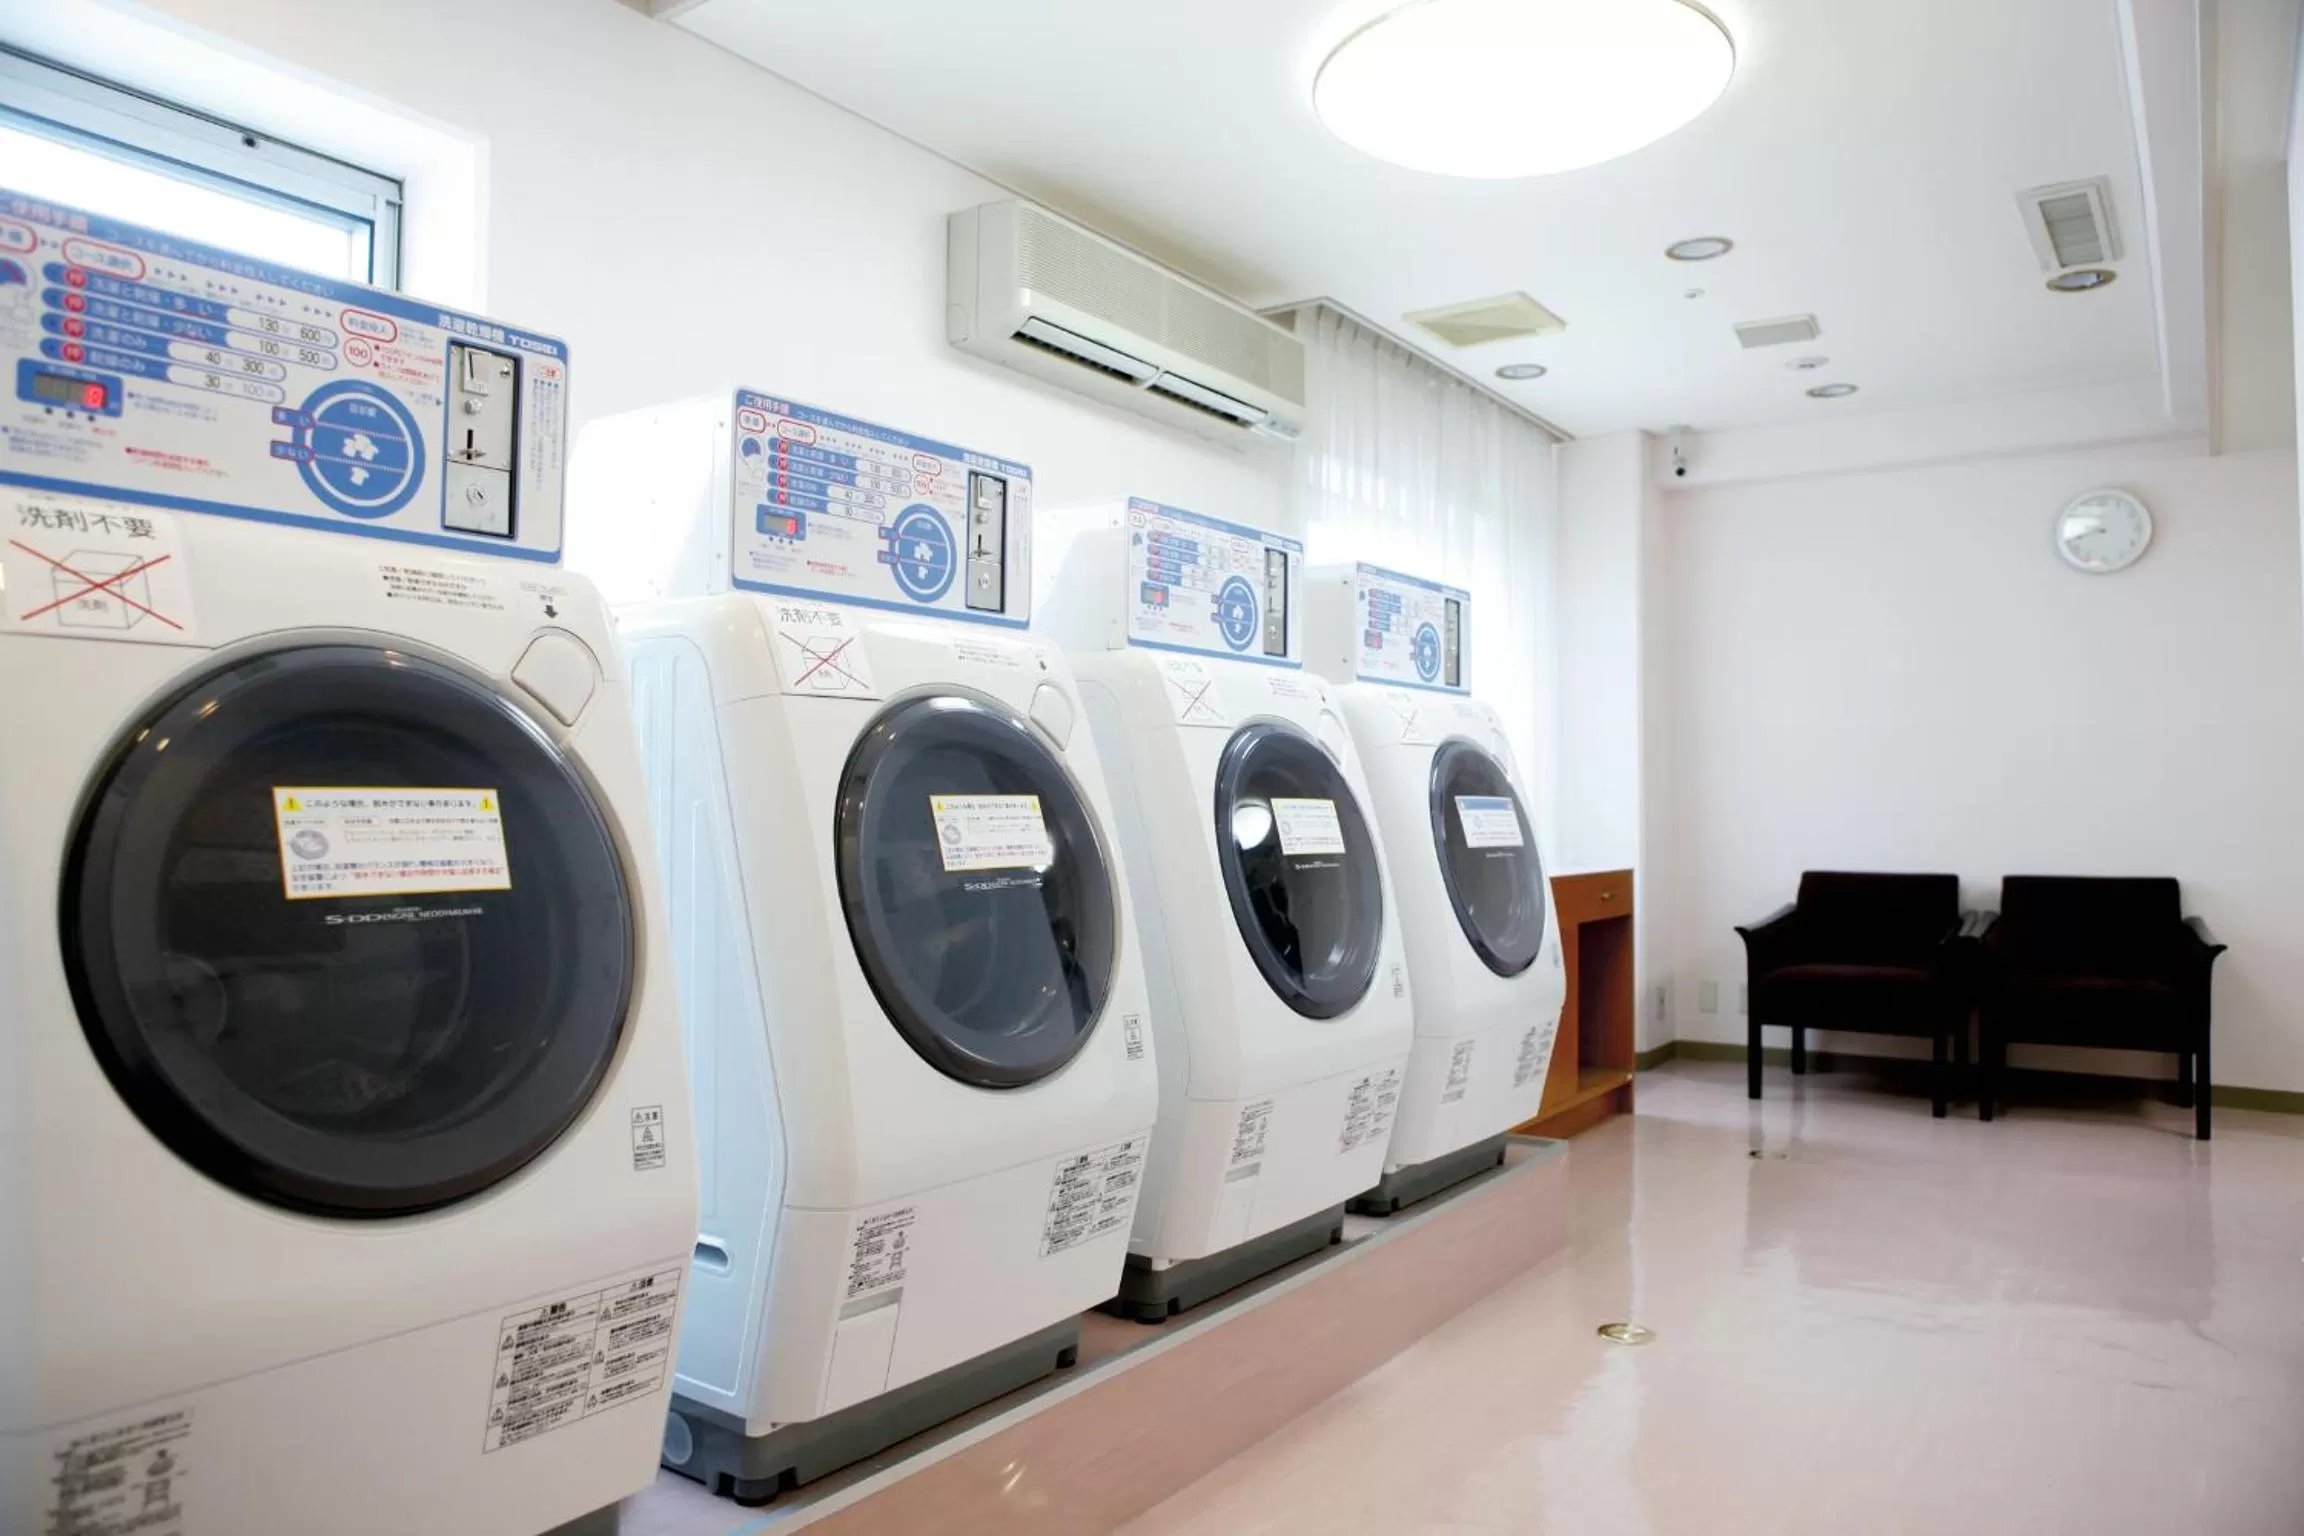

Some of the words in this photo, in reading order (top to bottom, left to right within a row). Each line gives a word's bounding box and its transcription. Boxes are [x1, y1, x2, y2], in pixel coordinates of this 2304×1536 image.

[259, 316, 279, 333] 130
[300, 325, 321, 343] 600
[205, 352, 221, 366] 40
[242, 358, 265, 375] 300
[259, 340, 279, 356] 100
[299, 347, 320, 365] 500
[204, 374, 221, 389] 30
